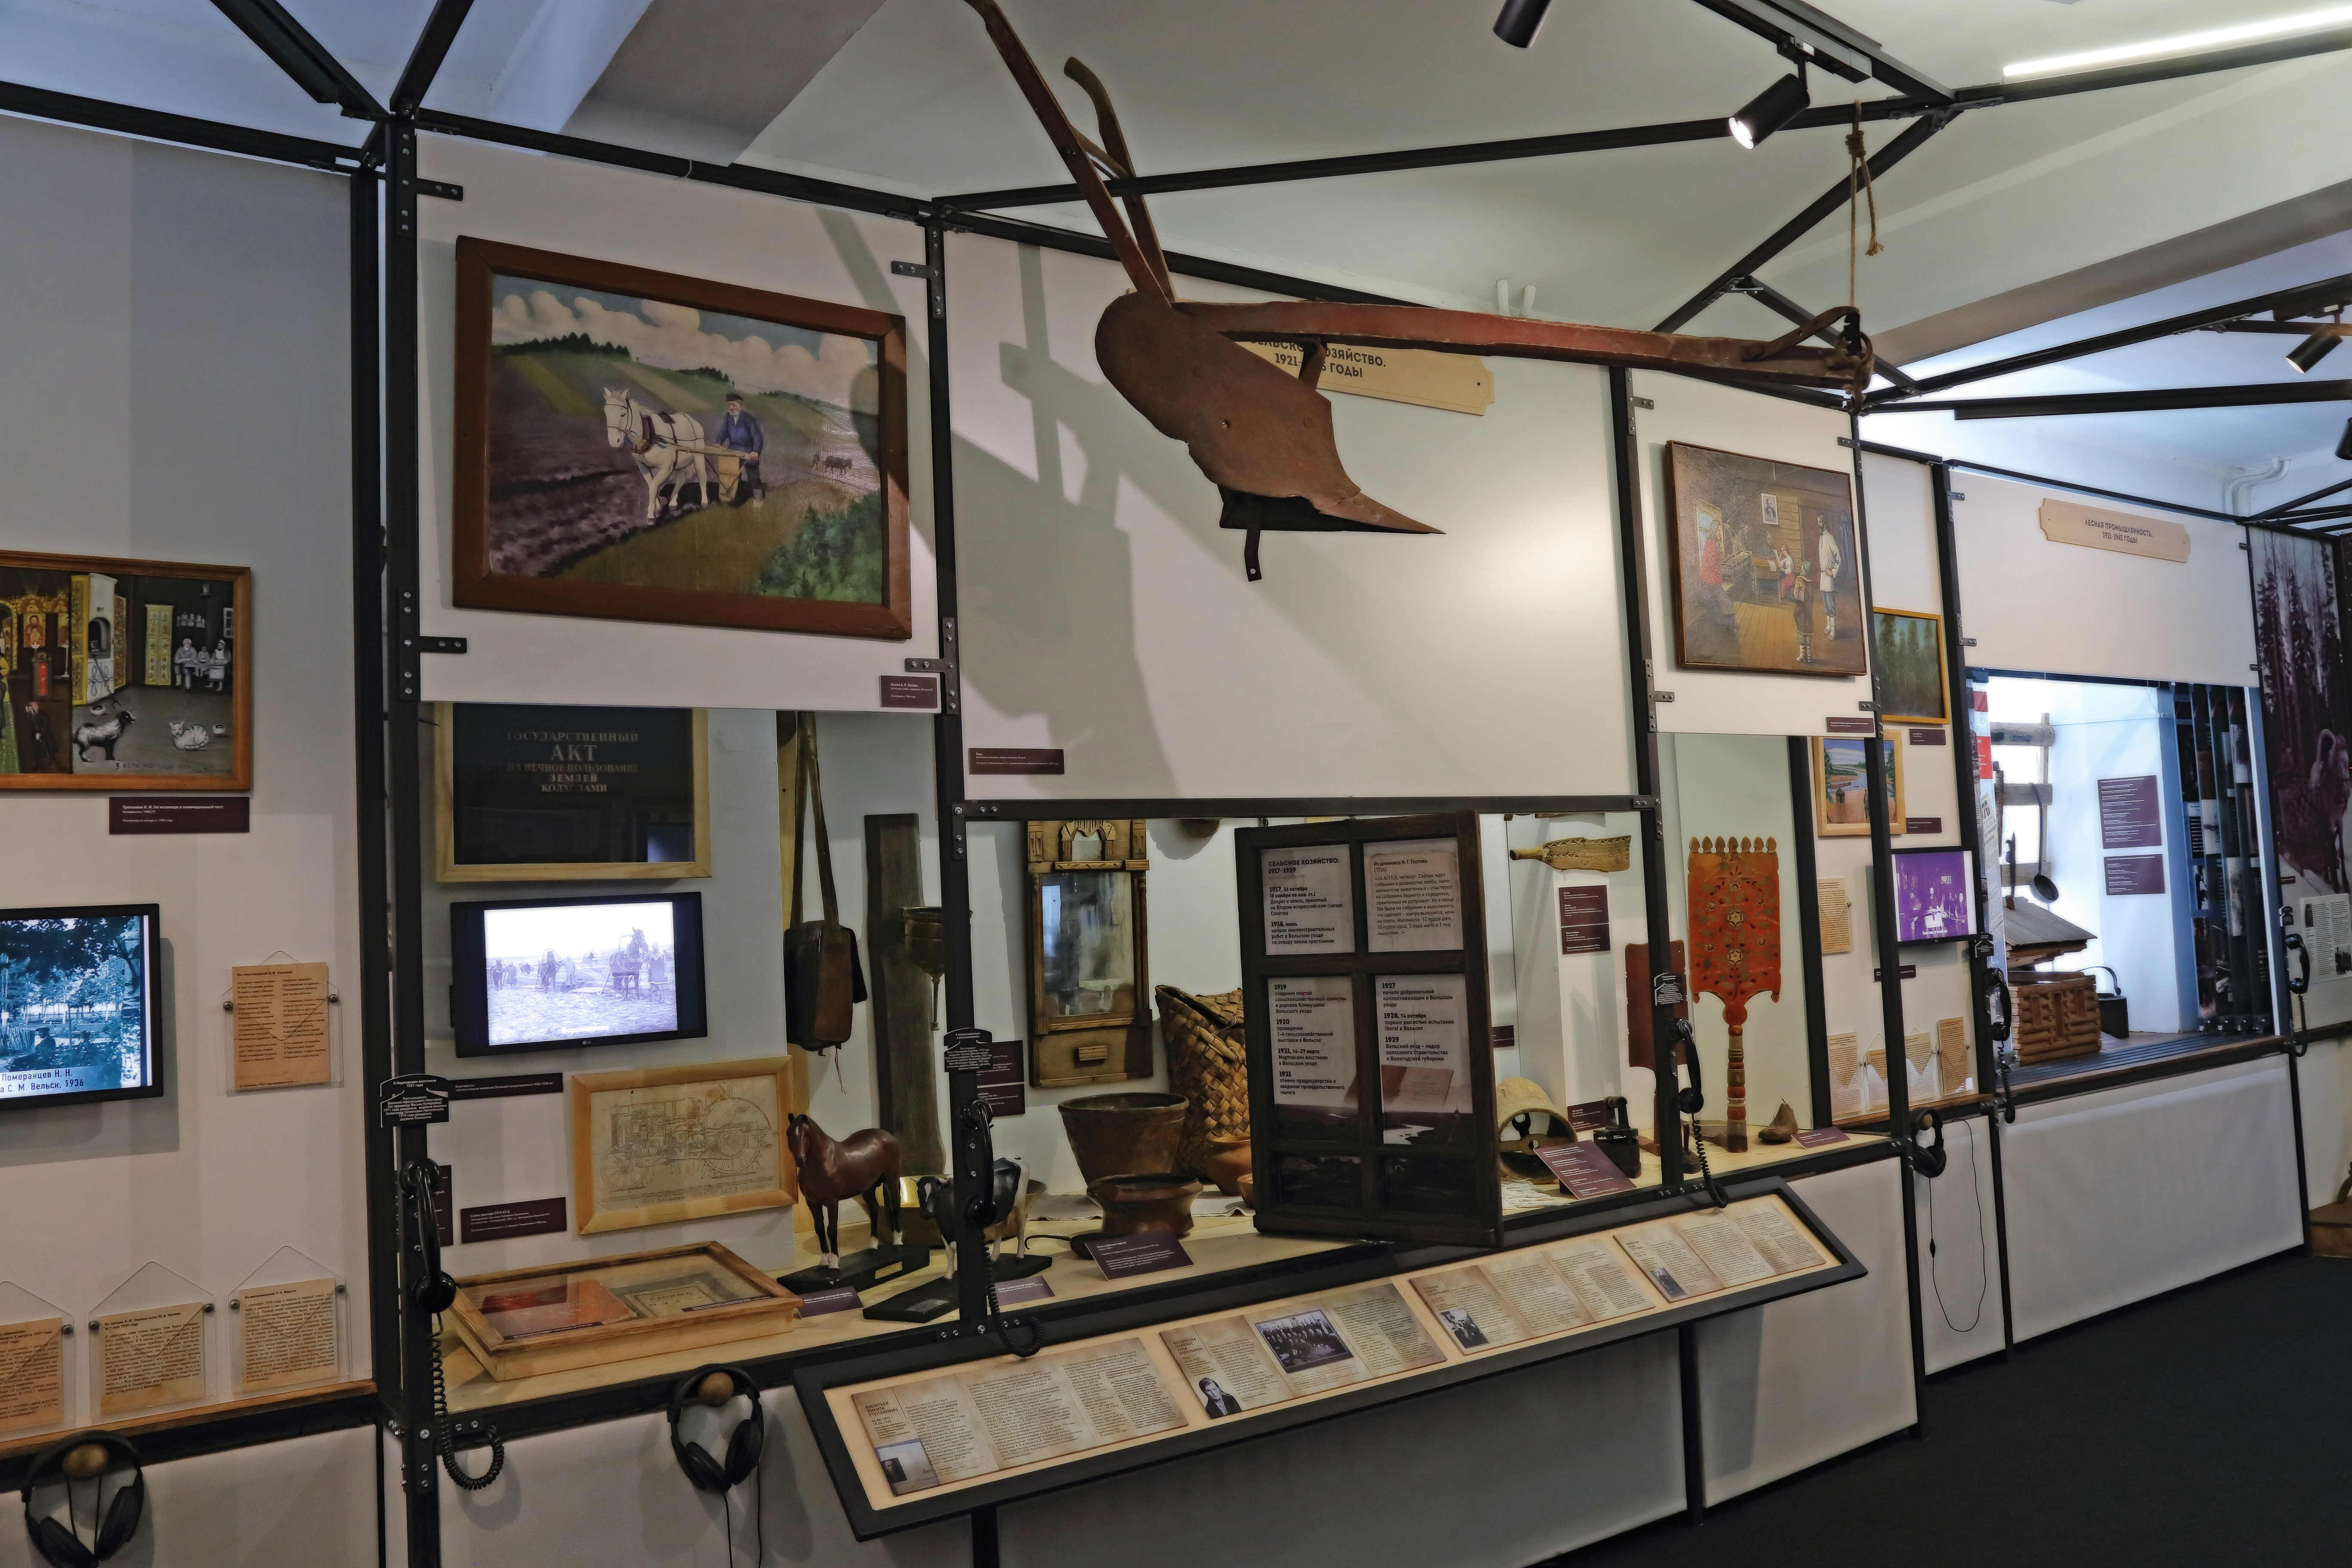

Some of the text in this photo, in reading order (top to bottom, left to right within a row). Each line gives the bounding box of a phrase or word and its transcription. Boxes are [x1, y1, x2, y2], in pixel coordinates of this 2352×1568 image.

[1325, 348, 1386, 367] ОЗЯЙСТВО.
[1330, 362, 1363, 377] ГОДЫ
[2085, 519, 2104, 528] ЛЕСНАЯ
[507, 731, 638, 741] ГОСУДАРСТВЕННЫЙ
[551, 744, 597, 761] АКТ
[508, 763, 521, 771] НА
[567, 764, 639, 772] ПОЛЬЗОВАНИЕ
[550, 772, 597, 782] ЗЕМЛЕЙ
[2, 1072, 51, 1081] Померанцев
[31, 1082, 61, 1090] Вельск,
[65, 1078, 84, 1087] 1936
[869, 1408, 898, 1416] СТЕПАНОВИЧ
